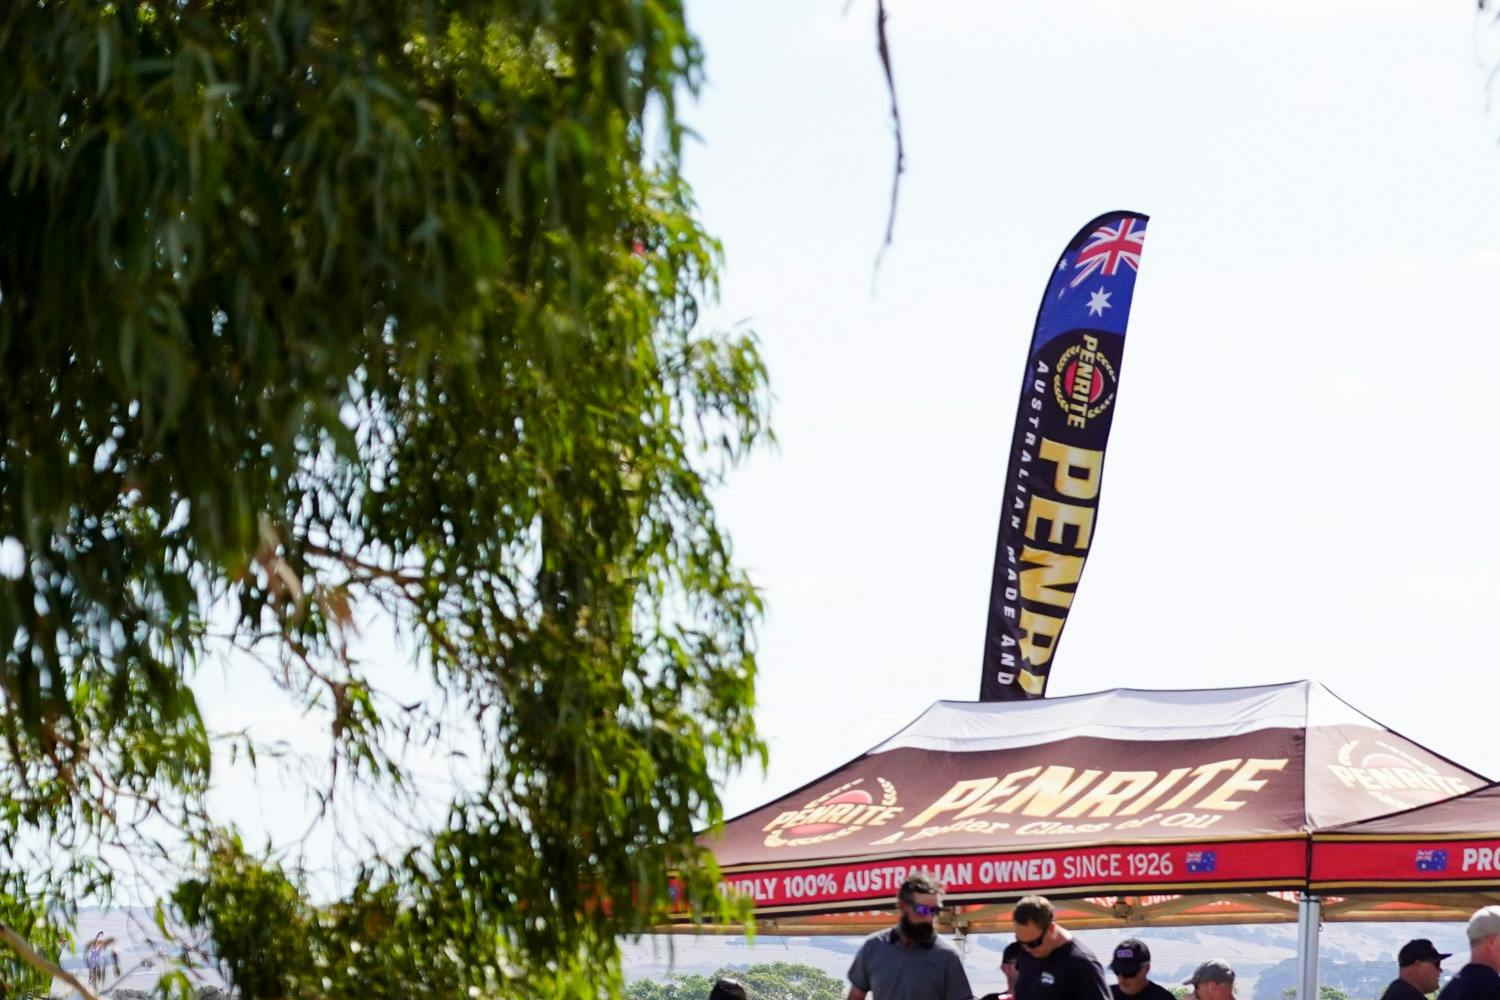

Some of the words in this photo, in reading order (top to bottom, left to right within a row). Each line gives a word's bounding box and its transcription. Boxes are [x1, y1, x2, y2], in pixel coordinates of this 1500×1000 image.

[1067, 334, 1098, 429] PENRITE
[1011, 359, 1049, 530] AUSTRALIAN
[1004, 545, 1017, 619] MADE
[997, 633, 1013, 686] AND
[903, 759, 1288, 827] PENRITE
[1328, 764, 1472, 796] PENRITE
[761, 804, 904, 832] PENRITE
[1015, 821, 1111, 835] Class
[1116, 814, 1153, 830] of
[1160, 812, 1221, 829] Oil
[784, 874, 837, 897] 100%
[980, 858, 1056, 883] OWNED
[1064, 854, 1121, 879] SINCE
[1128, 852, 1173, 877] 1926
